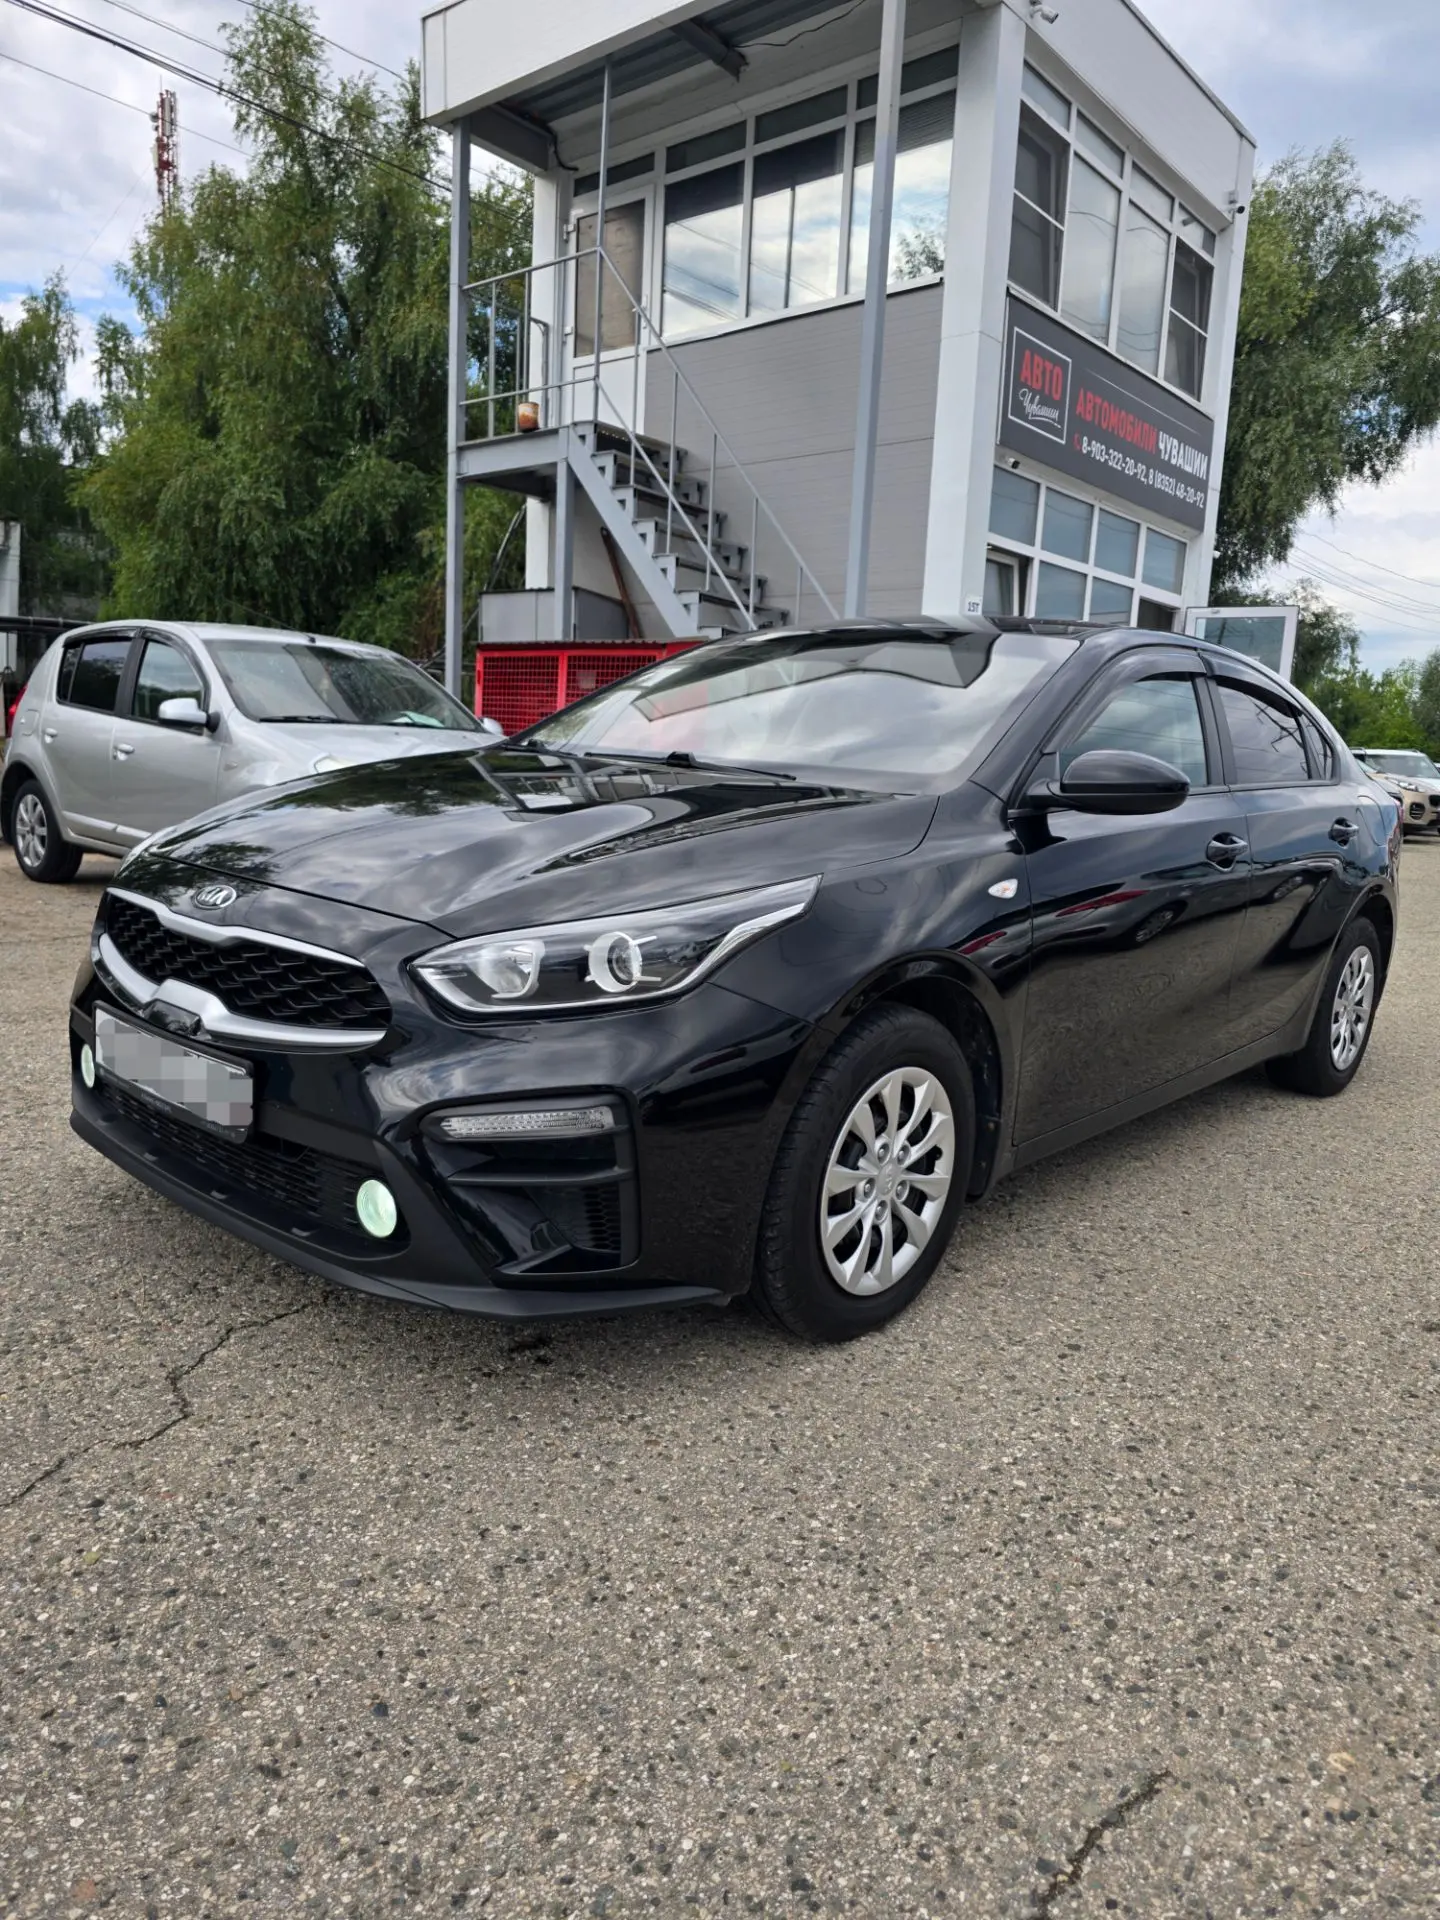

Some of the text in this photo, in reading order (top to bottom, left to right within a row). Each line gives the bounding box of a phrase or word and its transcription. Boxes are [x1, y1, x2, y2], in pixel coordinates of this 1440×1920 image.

[1020, 349, 1063, 401] АВТО
[1076, 387, 1209, 480] АВТОМОБИЛИ ЧУВАШИИ
[1082, 436, 1147, 484] 8-903-322-20-92,
[1148, 468, 1154, 485] 8
[1176, 482, 1206, 508] 48-20-92
[196, 886, 232, 906] KIA
